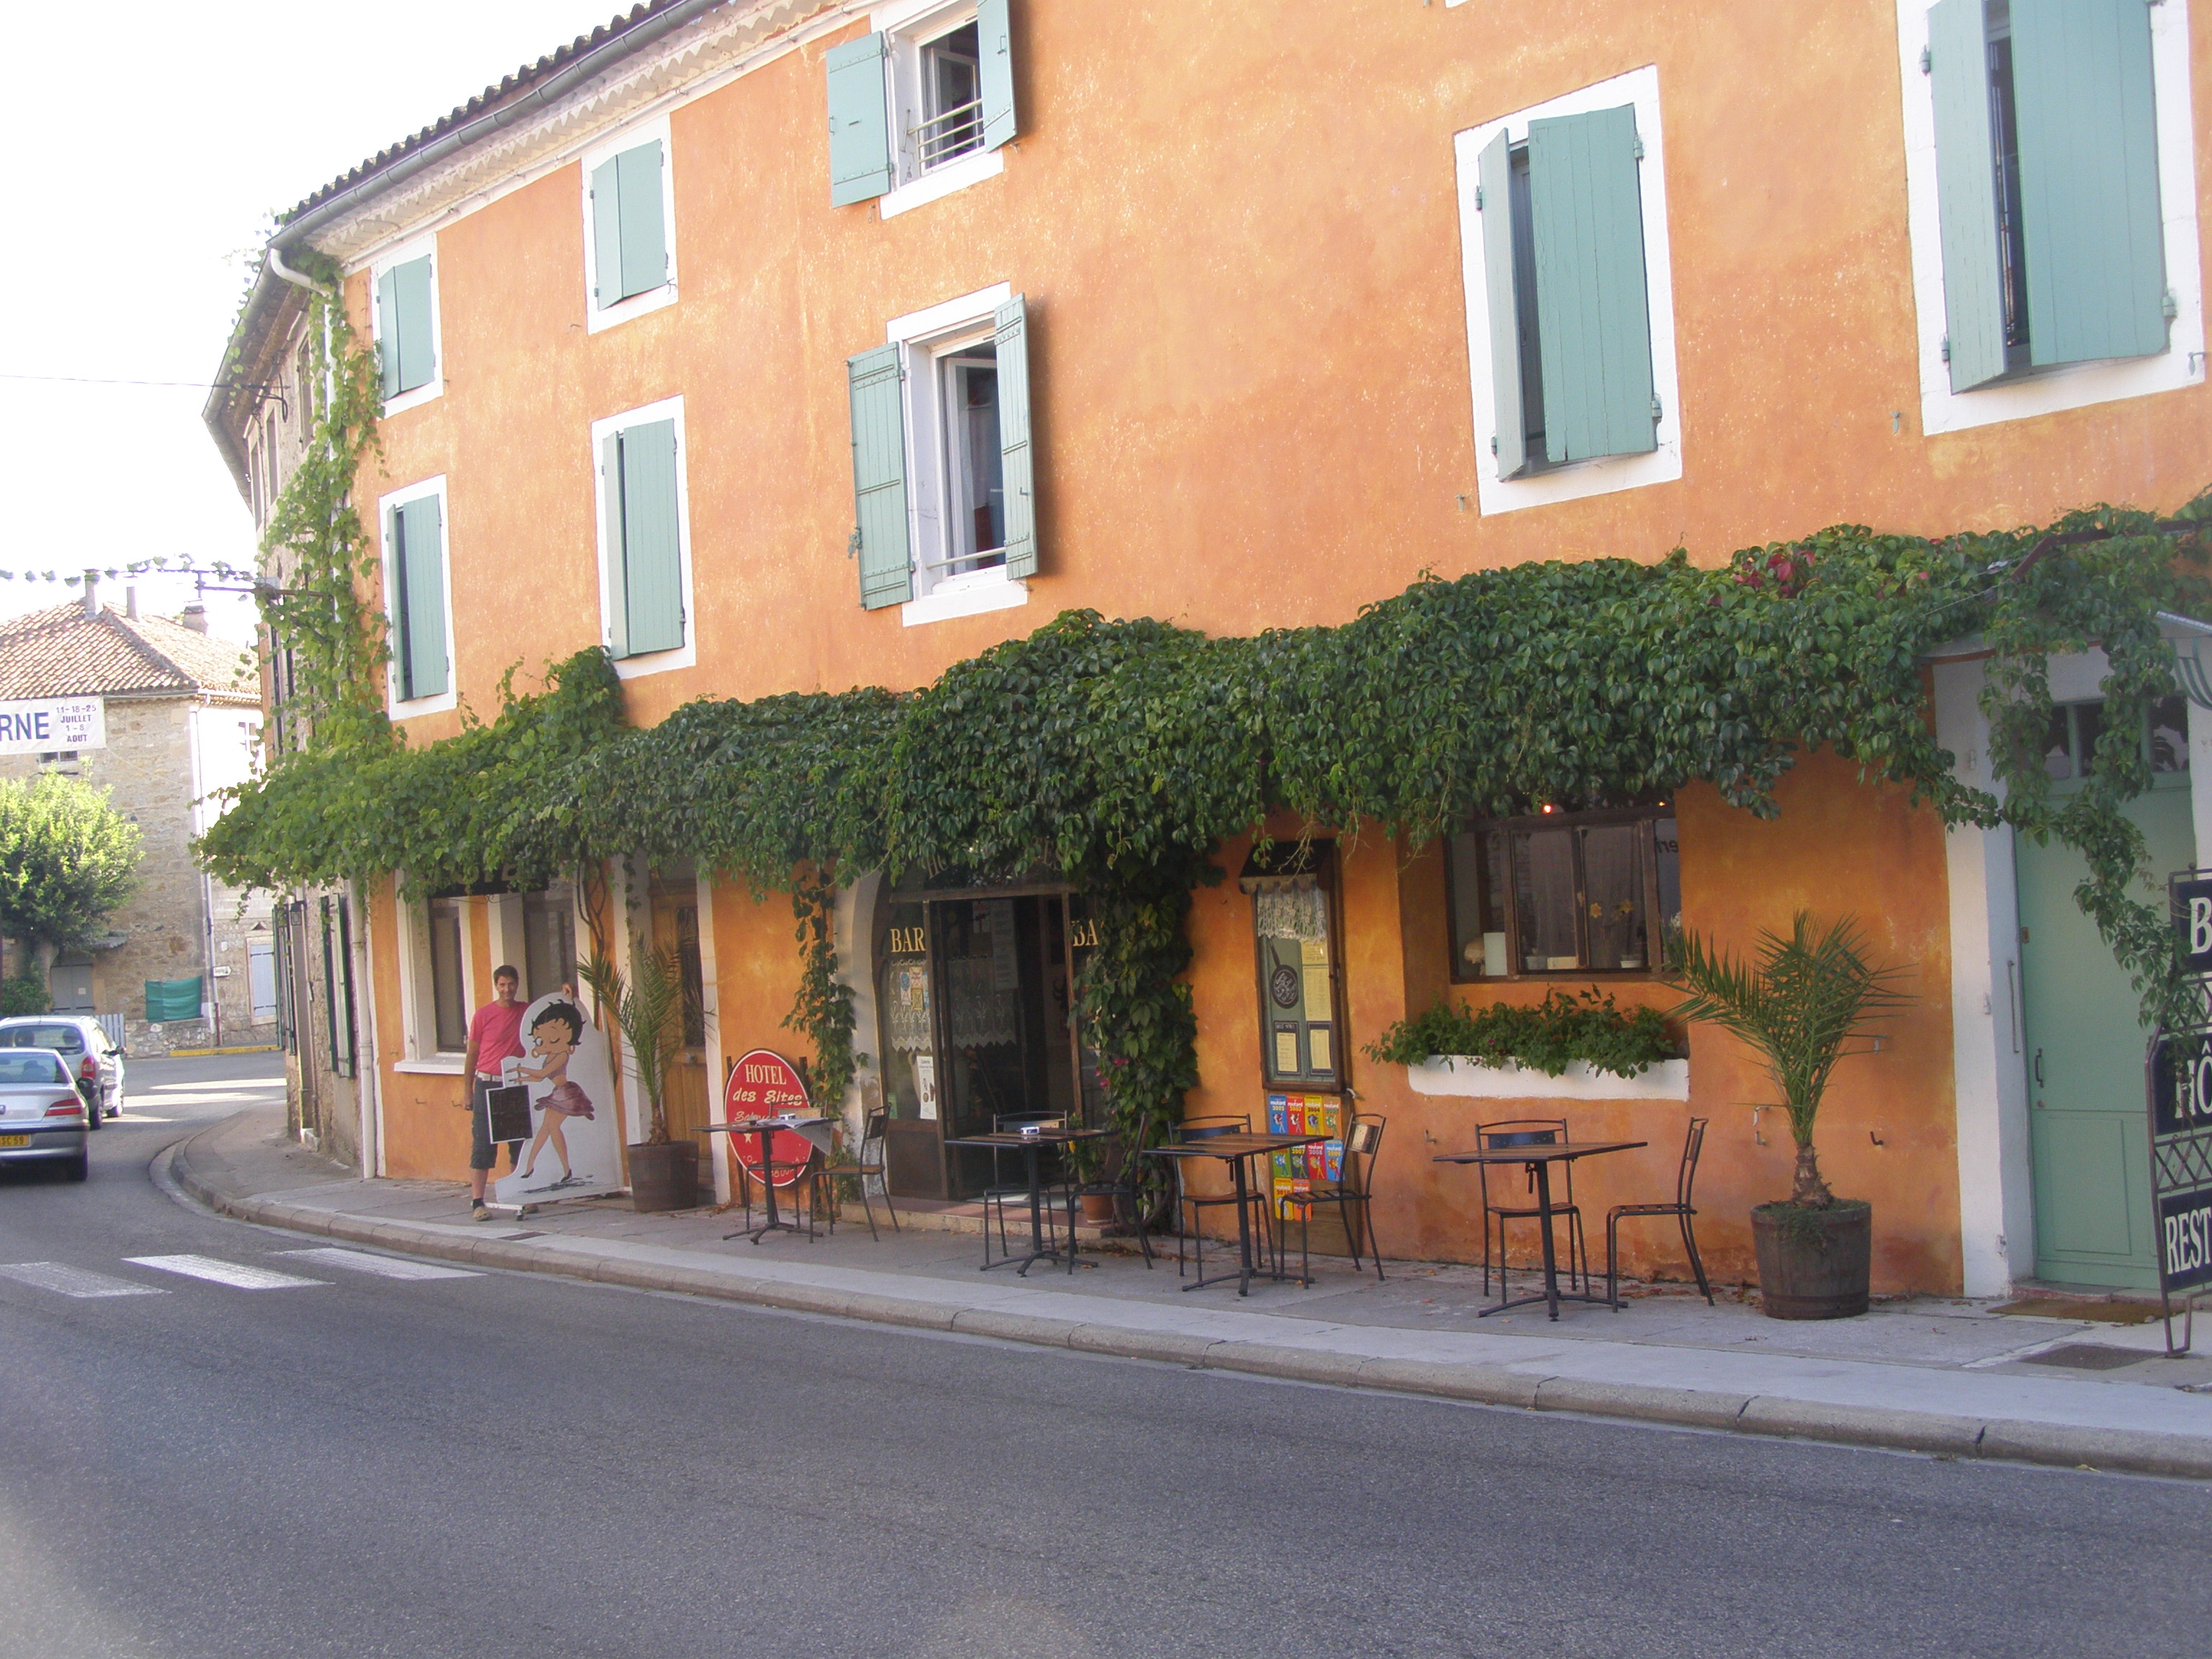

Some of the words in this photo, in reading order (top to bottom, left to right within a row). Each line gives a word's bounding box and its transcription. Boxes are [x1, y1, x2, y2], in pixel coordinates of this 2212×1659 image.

[0, 712, 50, 741] RNE
[60, 714, 91, 723] JUILLET
[890, 927, 926, 953] BAR
[1071, 918, 1104, 946] BA
[745, 1064, 786, 1084] HOTEL
[732, 1087, 756, 1102] des
[764, 1089, 803, 1105] Sites
[2164, 1207, 2211, 1274] REST
